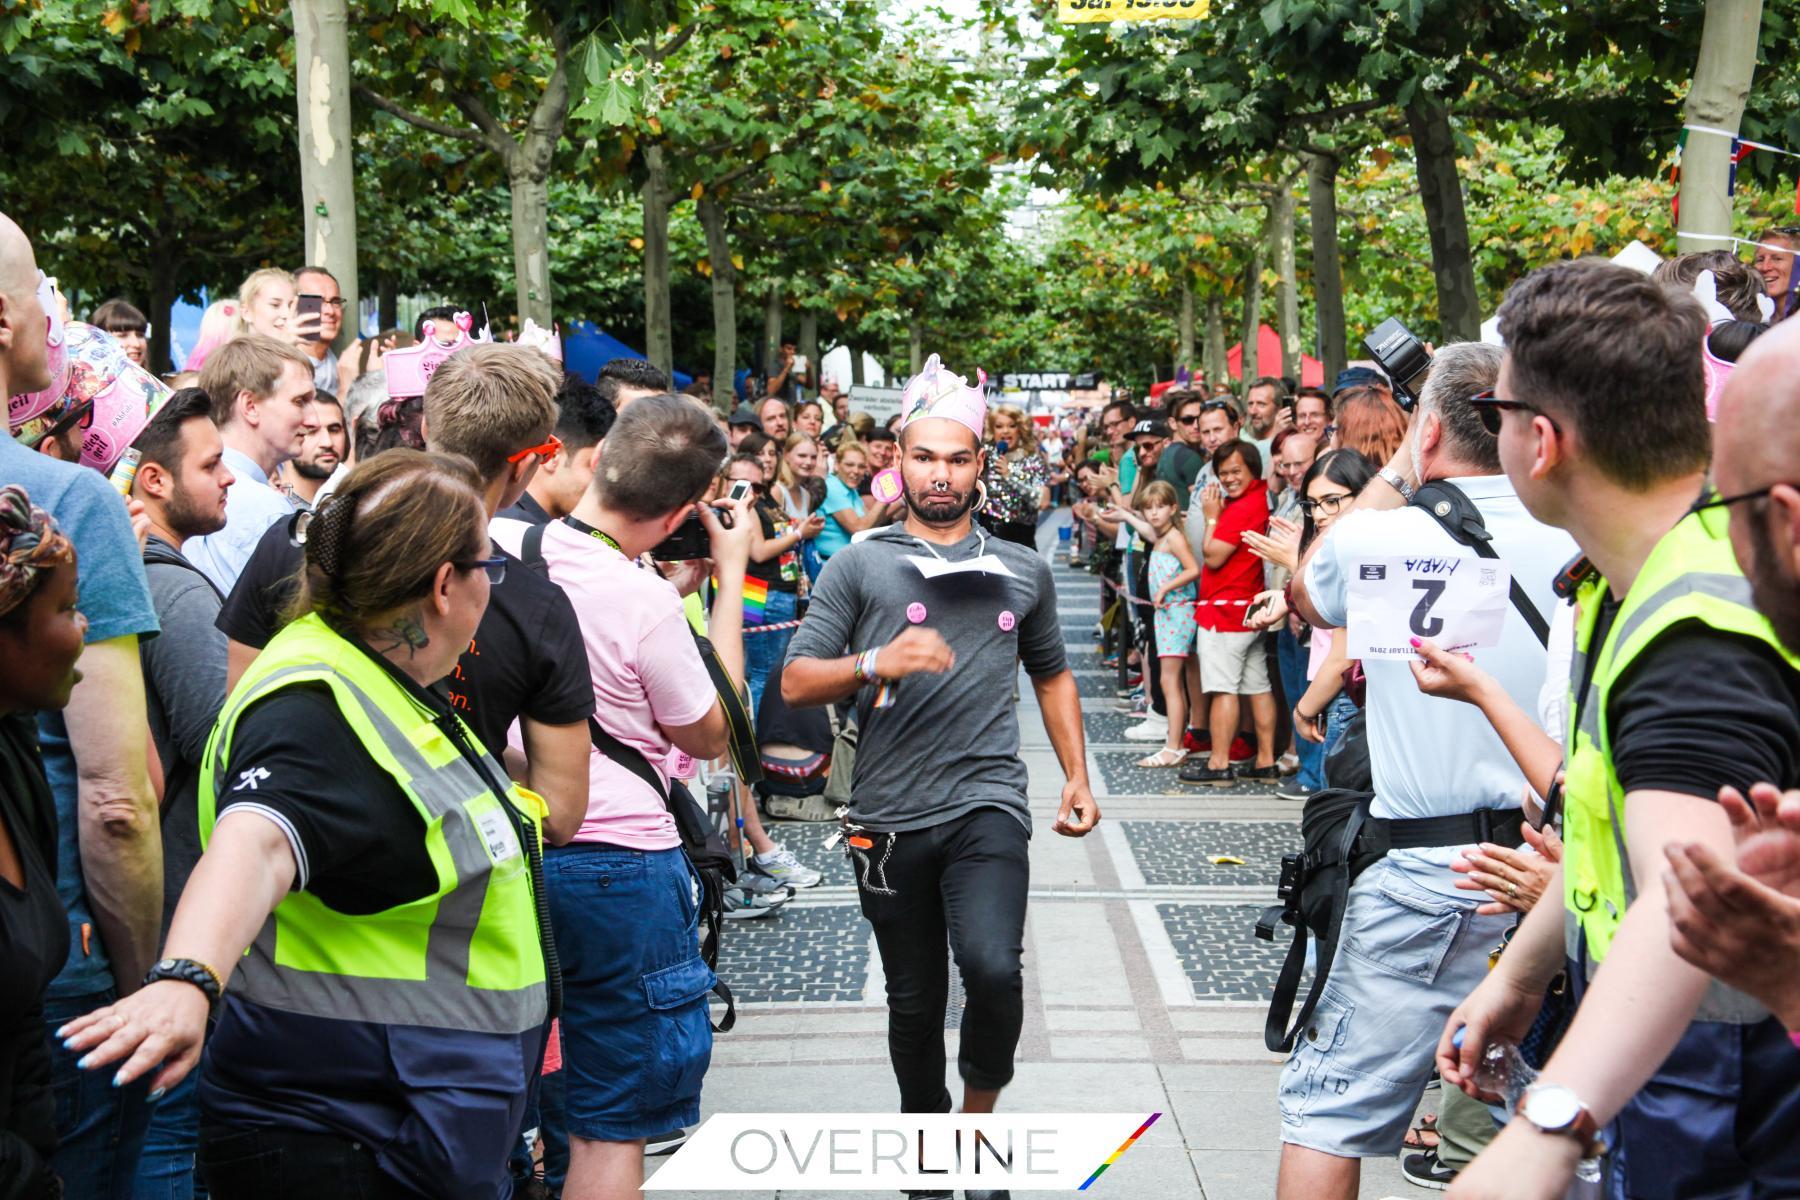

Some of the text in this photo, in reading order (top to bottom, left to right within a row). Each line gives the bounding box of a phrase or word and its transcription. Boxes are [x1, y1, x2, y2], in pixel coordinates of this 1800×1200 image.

[1003, 373, 1070, 388] START
[1405, 558, 1461, 575] MARIA
[1410, 580, 1446, 637] 2
[1369, 646, 1388, 654] 2016
